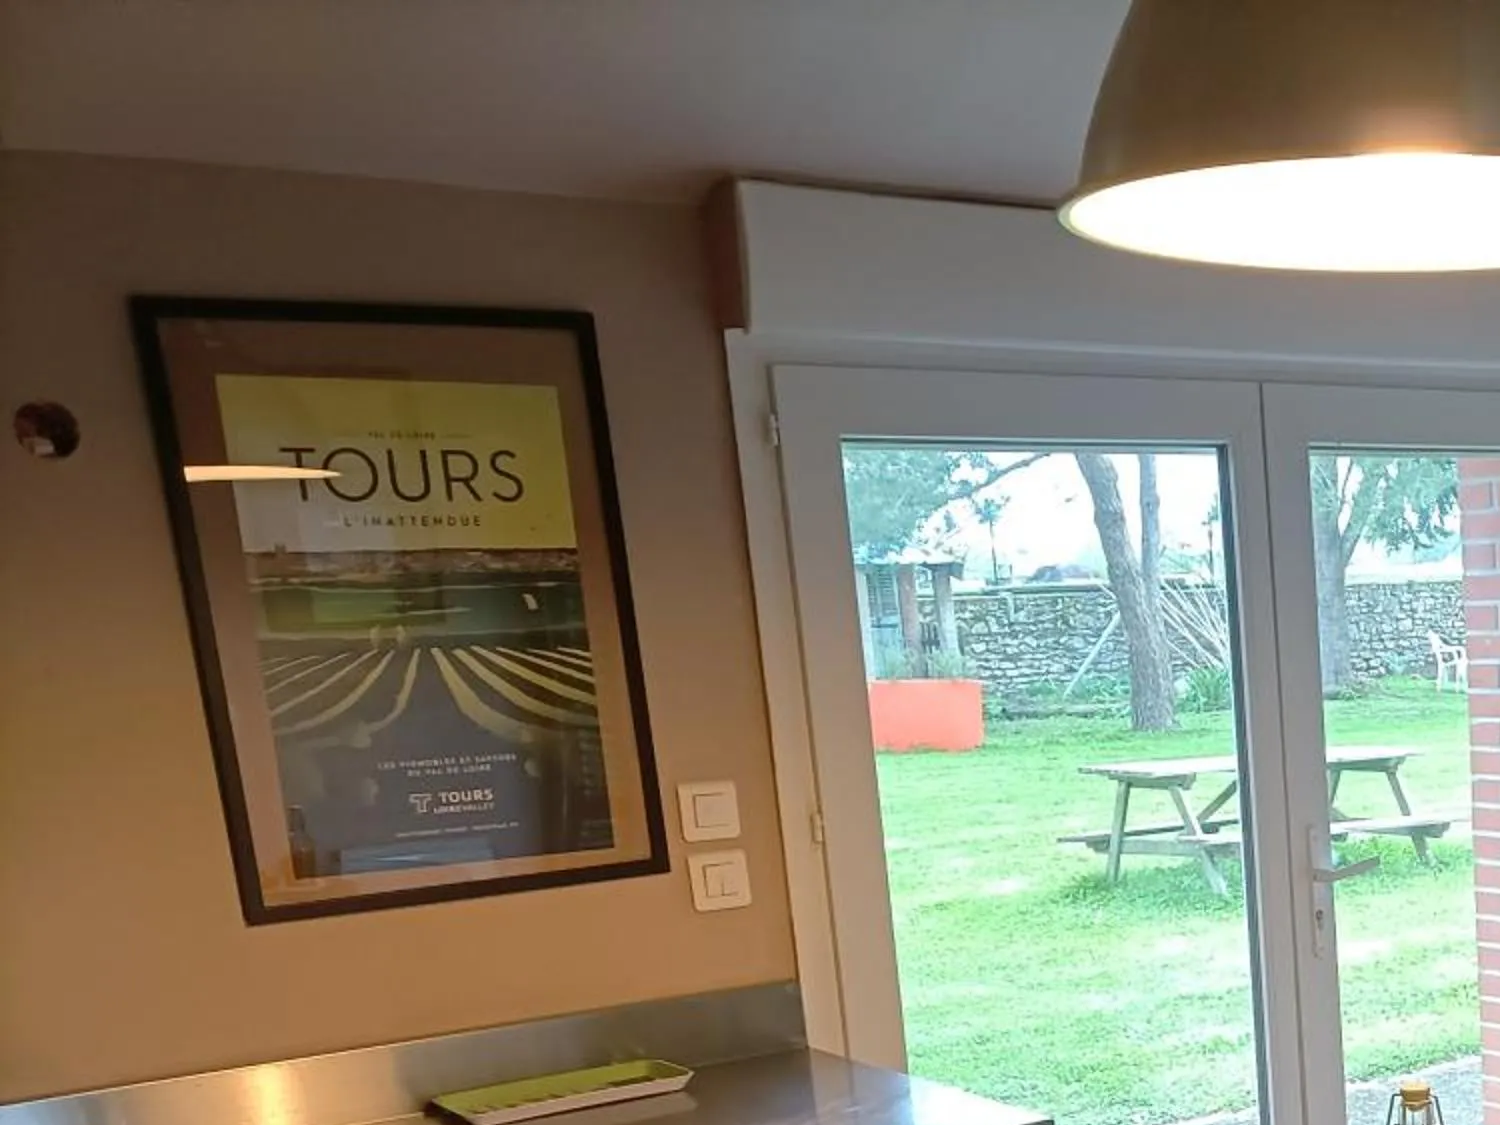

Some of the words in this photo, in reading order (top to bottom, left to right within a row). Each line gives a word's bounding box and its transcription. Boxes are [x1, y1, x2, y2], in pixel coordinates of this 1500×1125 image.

[279, 447, 524, 502] TOURS
[343, 514, 482, 528] L'INATTENDUE
[437, 788, 494, 804] TOURS
